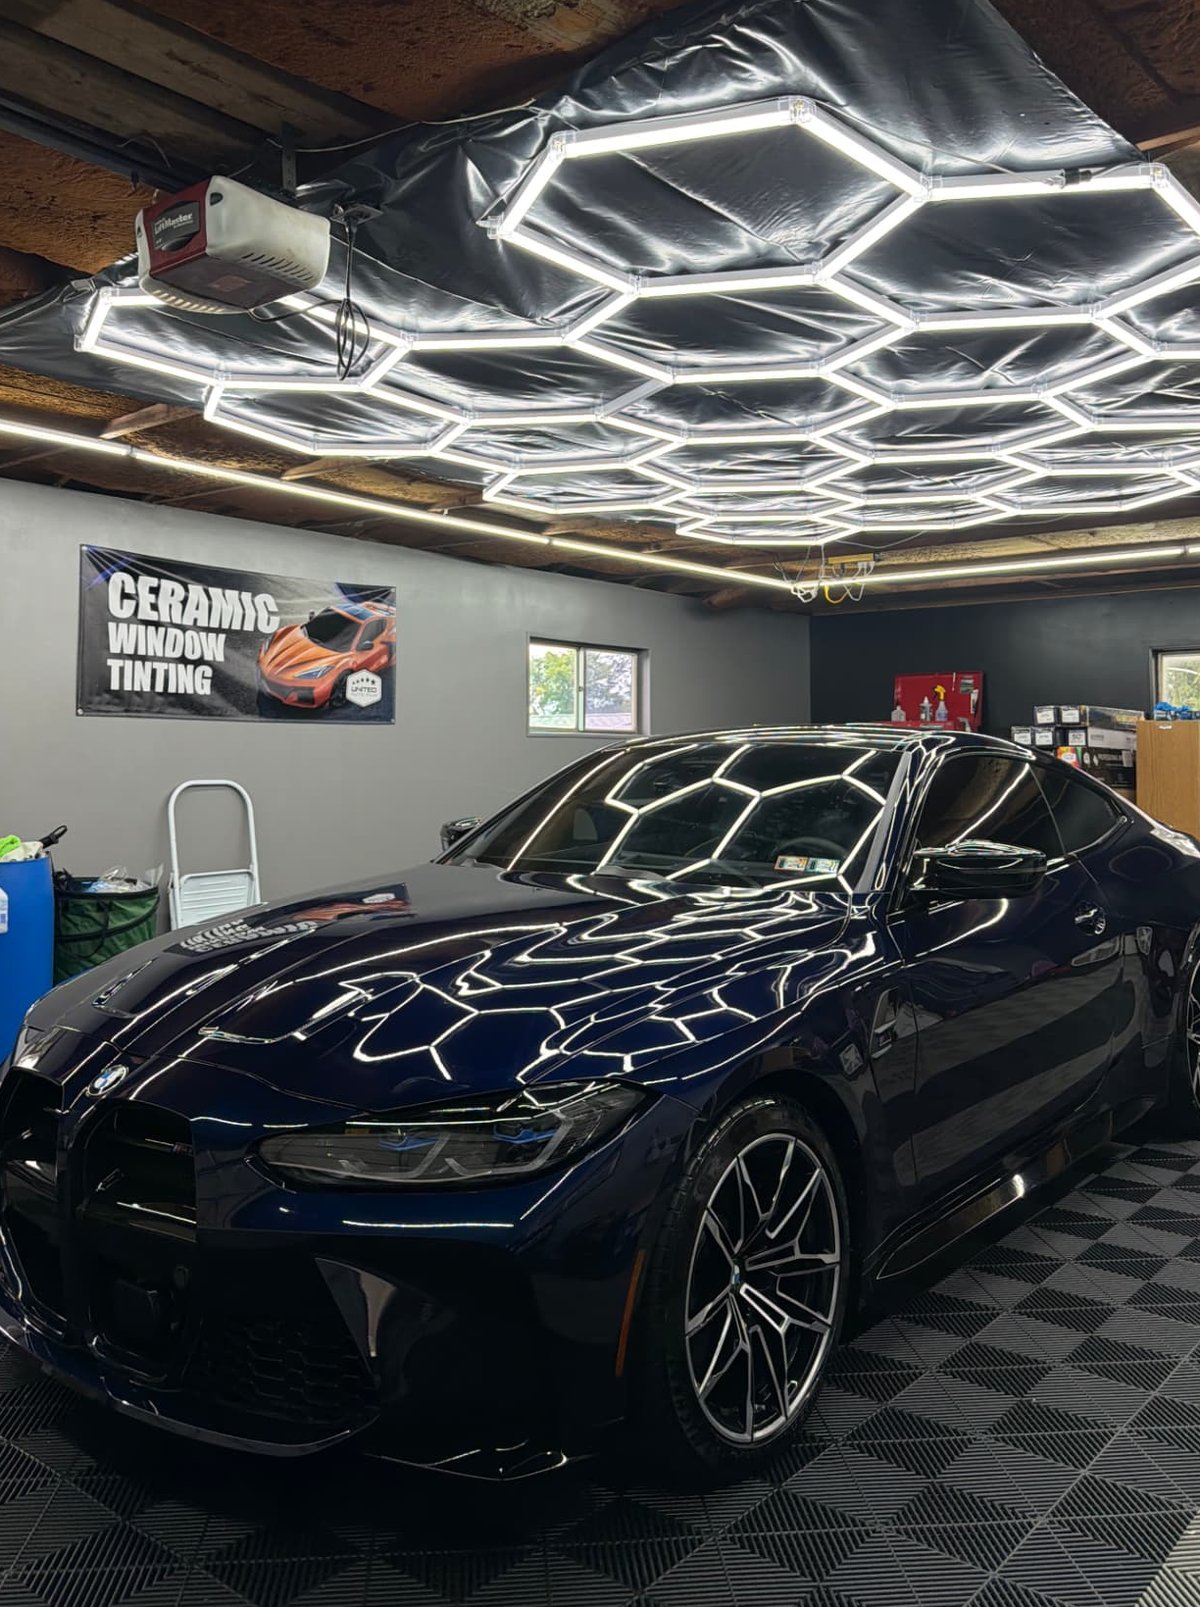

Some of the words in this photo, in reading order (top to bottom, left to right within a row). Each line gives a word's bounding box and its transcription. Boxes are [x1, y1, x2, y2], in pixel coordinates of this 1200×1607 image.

[108, 571, 280, 634] CERAMIC
[108, 622, 226, 662] WINDOW
[107, 659, 213, 695] TINTING
